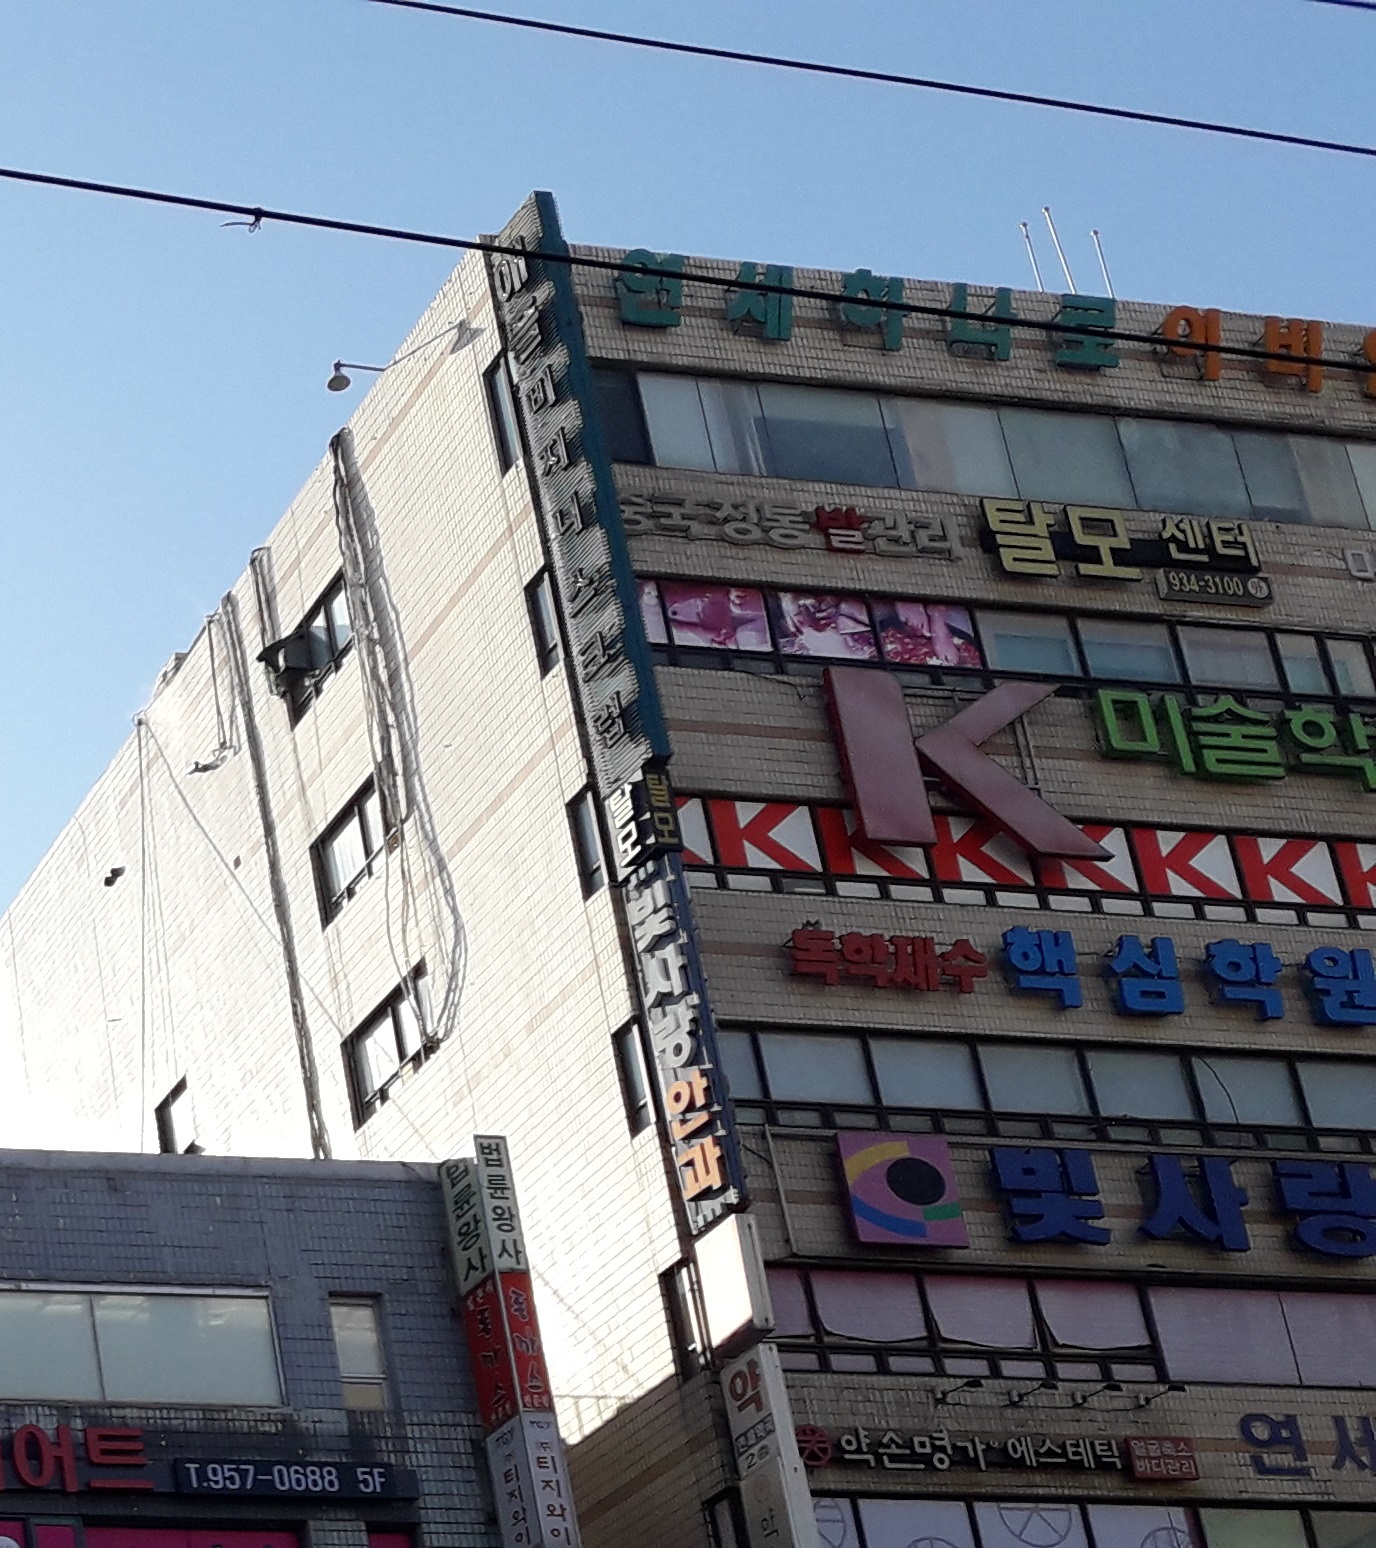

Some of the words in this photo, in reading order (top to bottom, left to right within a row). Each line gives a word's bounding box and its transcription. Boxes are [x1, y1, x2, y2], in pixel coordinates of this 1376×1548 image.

[615, 248, 1120, 372] 연세하나로
[983, 498, 1143, 582] 탈모
[1158, 514, 1258, 570] 센터
[1168, 570, 1245, 599] 934-3100
[823, 664, 1116, 863] K
[790, 920, 990, 996] 독학재수
[1002, 922, 1376, 1030] 핵심학원
[185, 1462, 341, 1494] T.957-0688
[356, 1465, 388, 1496] 5F
[839, 1426, 990, 1473] 약손명가
[1006, 1434, 1124, 1471] 에스테틱
